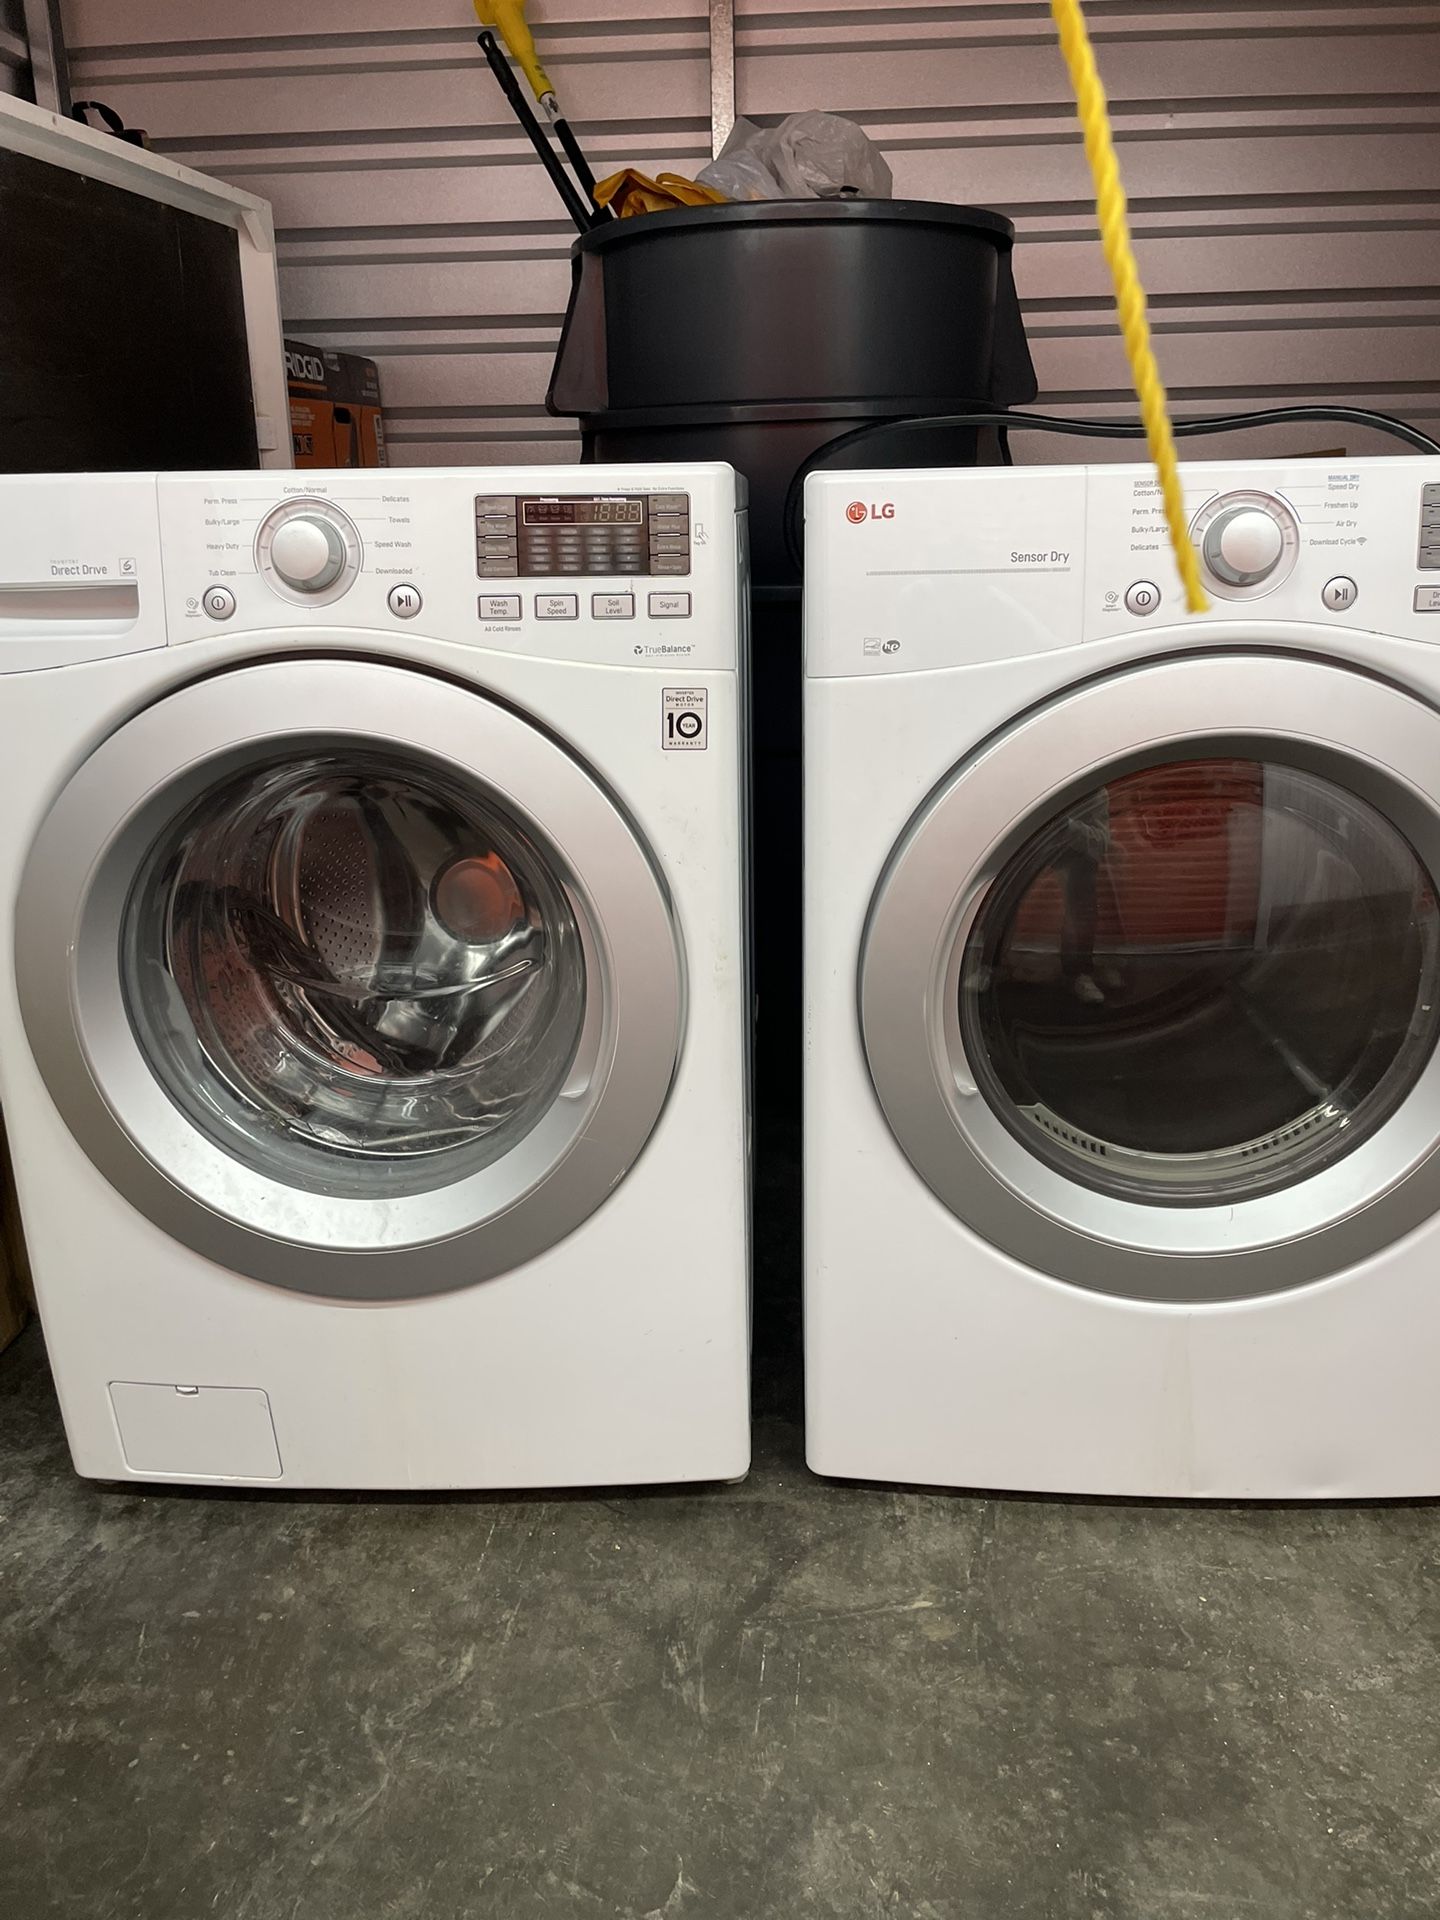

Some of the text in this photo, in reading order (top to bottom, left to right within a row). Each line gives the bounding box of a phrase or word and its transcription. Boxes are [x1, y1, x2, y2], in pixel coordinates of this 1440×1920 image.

[285, 352, 324, 381] RIDGID
[1348, 483, 1360, 491] Dry
[871, 503, 895, 520] LG
[205, 518, 240, 526] Bulky/Large
[1346, 520, 1358, 528] Dry
[1340, 538, 1356, 546] Cycle
[1011, 550, 1070, 564] Sensor Dry
[51, 564, 107, 575] Direct Drive
[549, 599, 563, 608] Spin
[660, 601, 679, 609] Signal
[547, 608, 567, 616] Speed
[667, 712, 702, 738] 10
